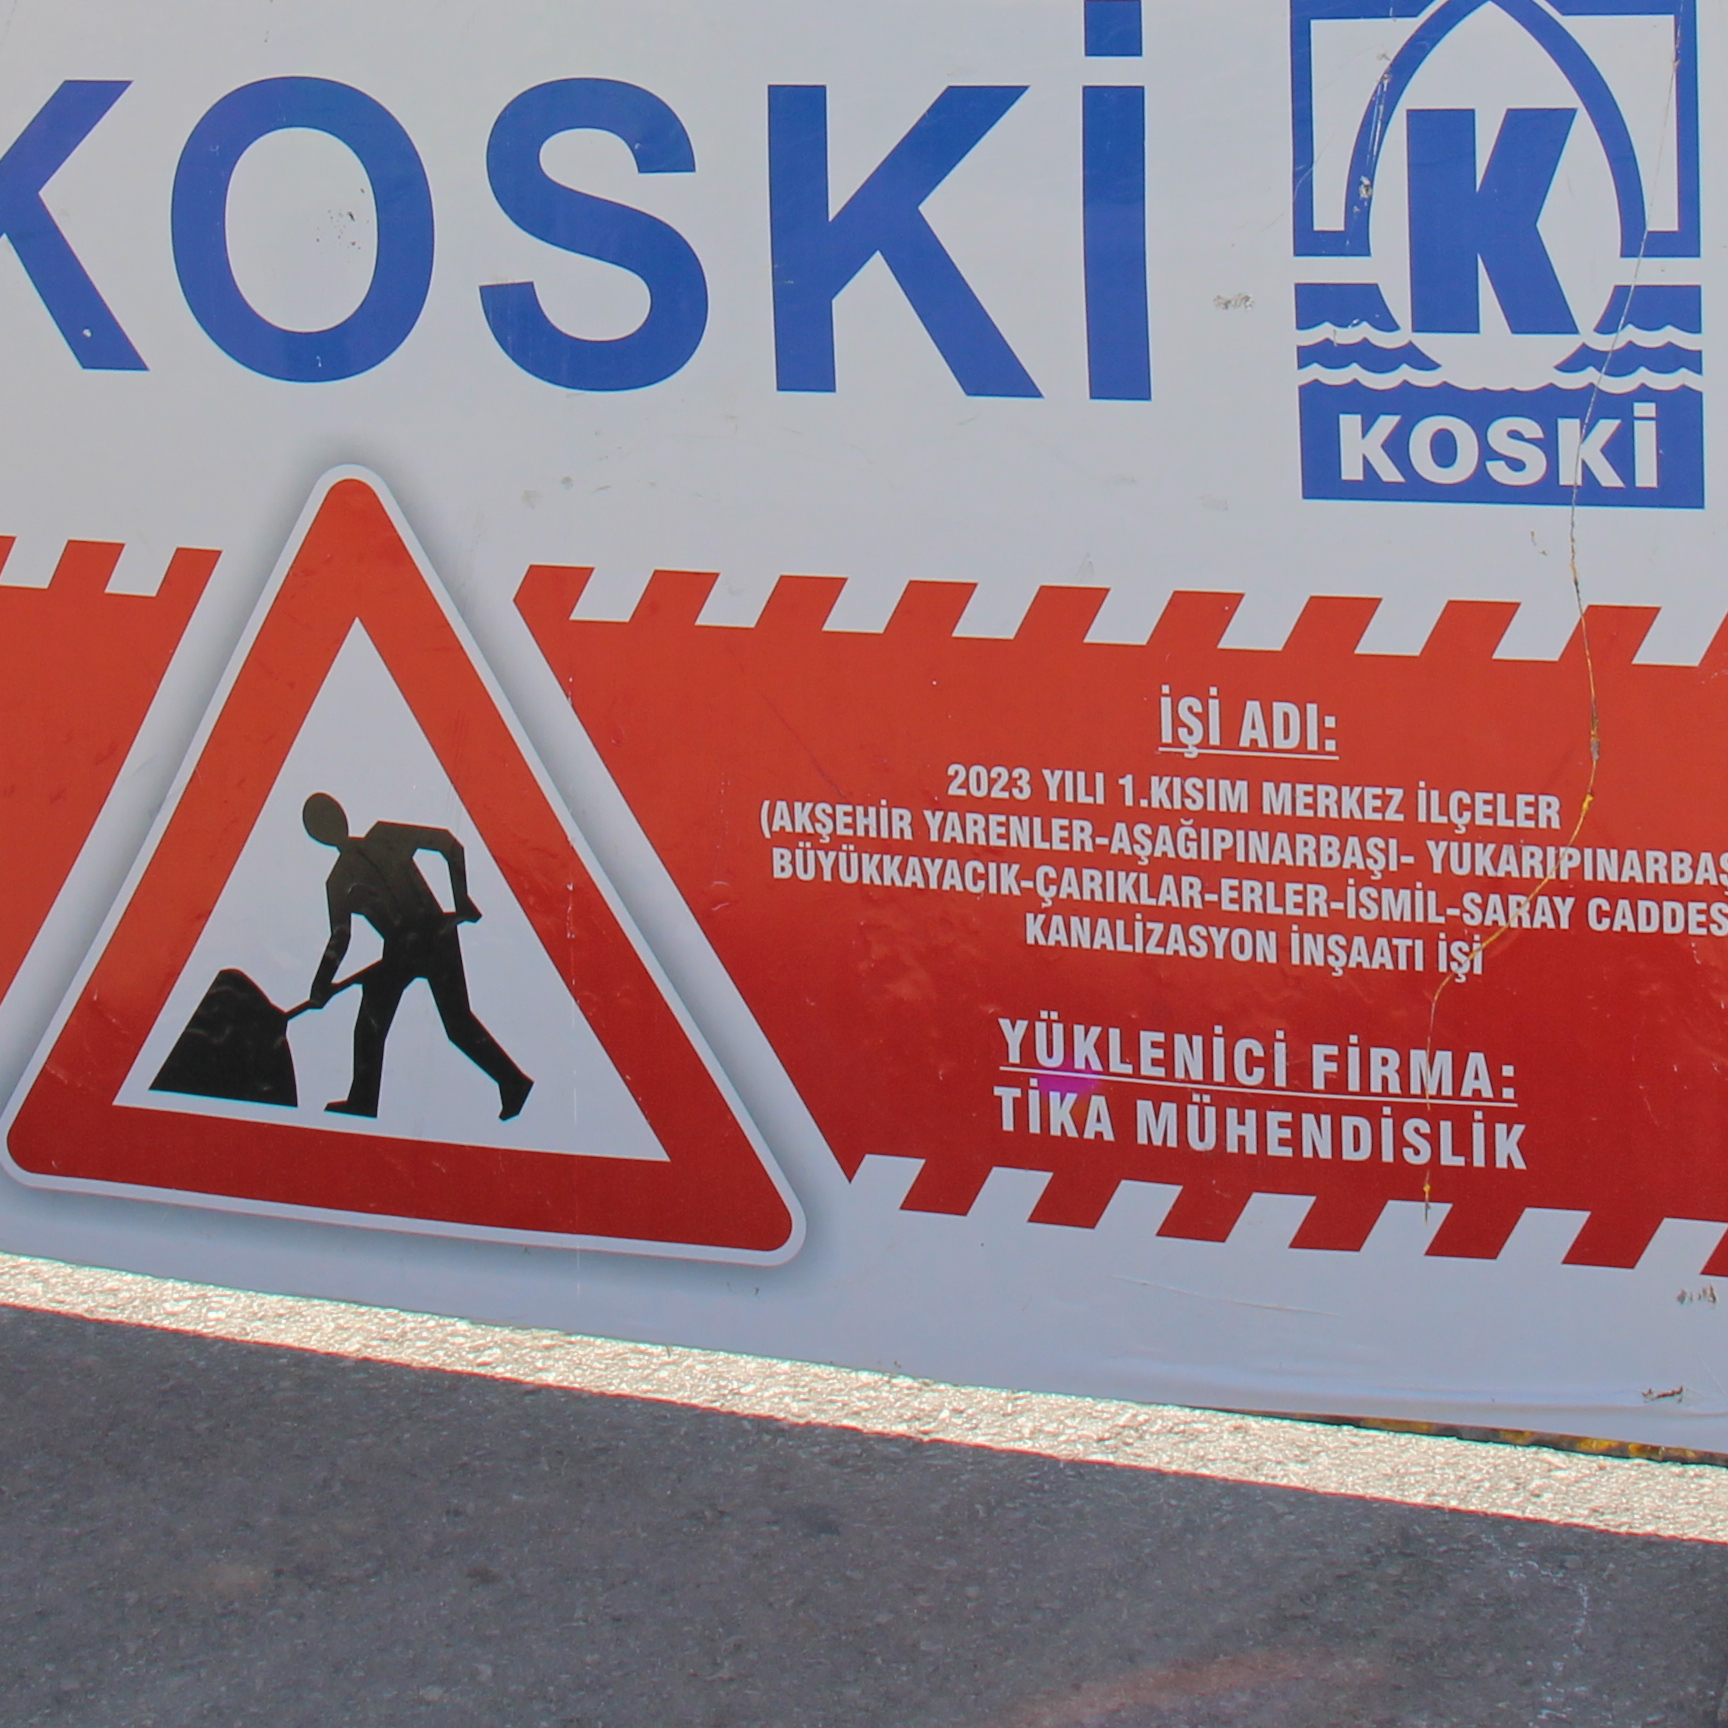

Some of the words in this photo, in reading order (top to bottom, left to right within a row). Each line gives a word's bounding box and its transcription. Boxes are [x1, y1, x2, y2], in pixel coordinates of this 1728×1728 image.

[1338, 402, 1659, 489] KOSKİ
[1159, 684, 1221, 758] İŞİ
[1238, 699, 1338, 752] ADI:
[947, 763, 1032, 800] 2023
[1042, 768, 1105, 805] YILI
[1118, 774, 1249, 813] 1.KISIM
[1262, 781, 1404, 822] MERKEZ
[1417, 781, 1561, 834] İLÇELER
[761, 799, 913, 843] (AKŞEHİR
[923, 810, 1415, 880] YARENLER-AŞAĞIPINARBAŞI-
[1025, 912, 1277, 964] KANALİZASYON
[1291, 925, 1424, 977] İNŞAATI
[1437, 929, 1484, 983] İŞİ
[998, 1010, 1287, 1088] YÜKLENİCİ
[1312, 1034, 1516, 1100] FİRMA:
[994, 1077, 1115, 1142] TİKA
[1137, 1093, 1527, 1170] MÜHENDİSLİK
